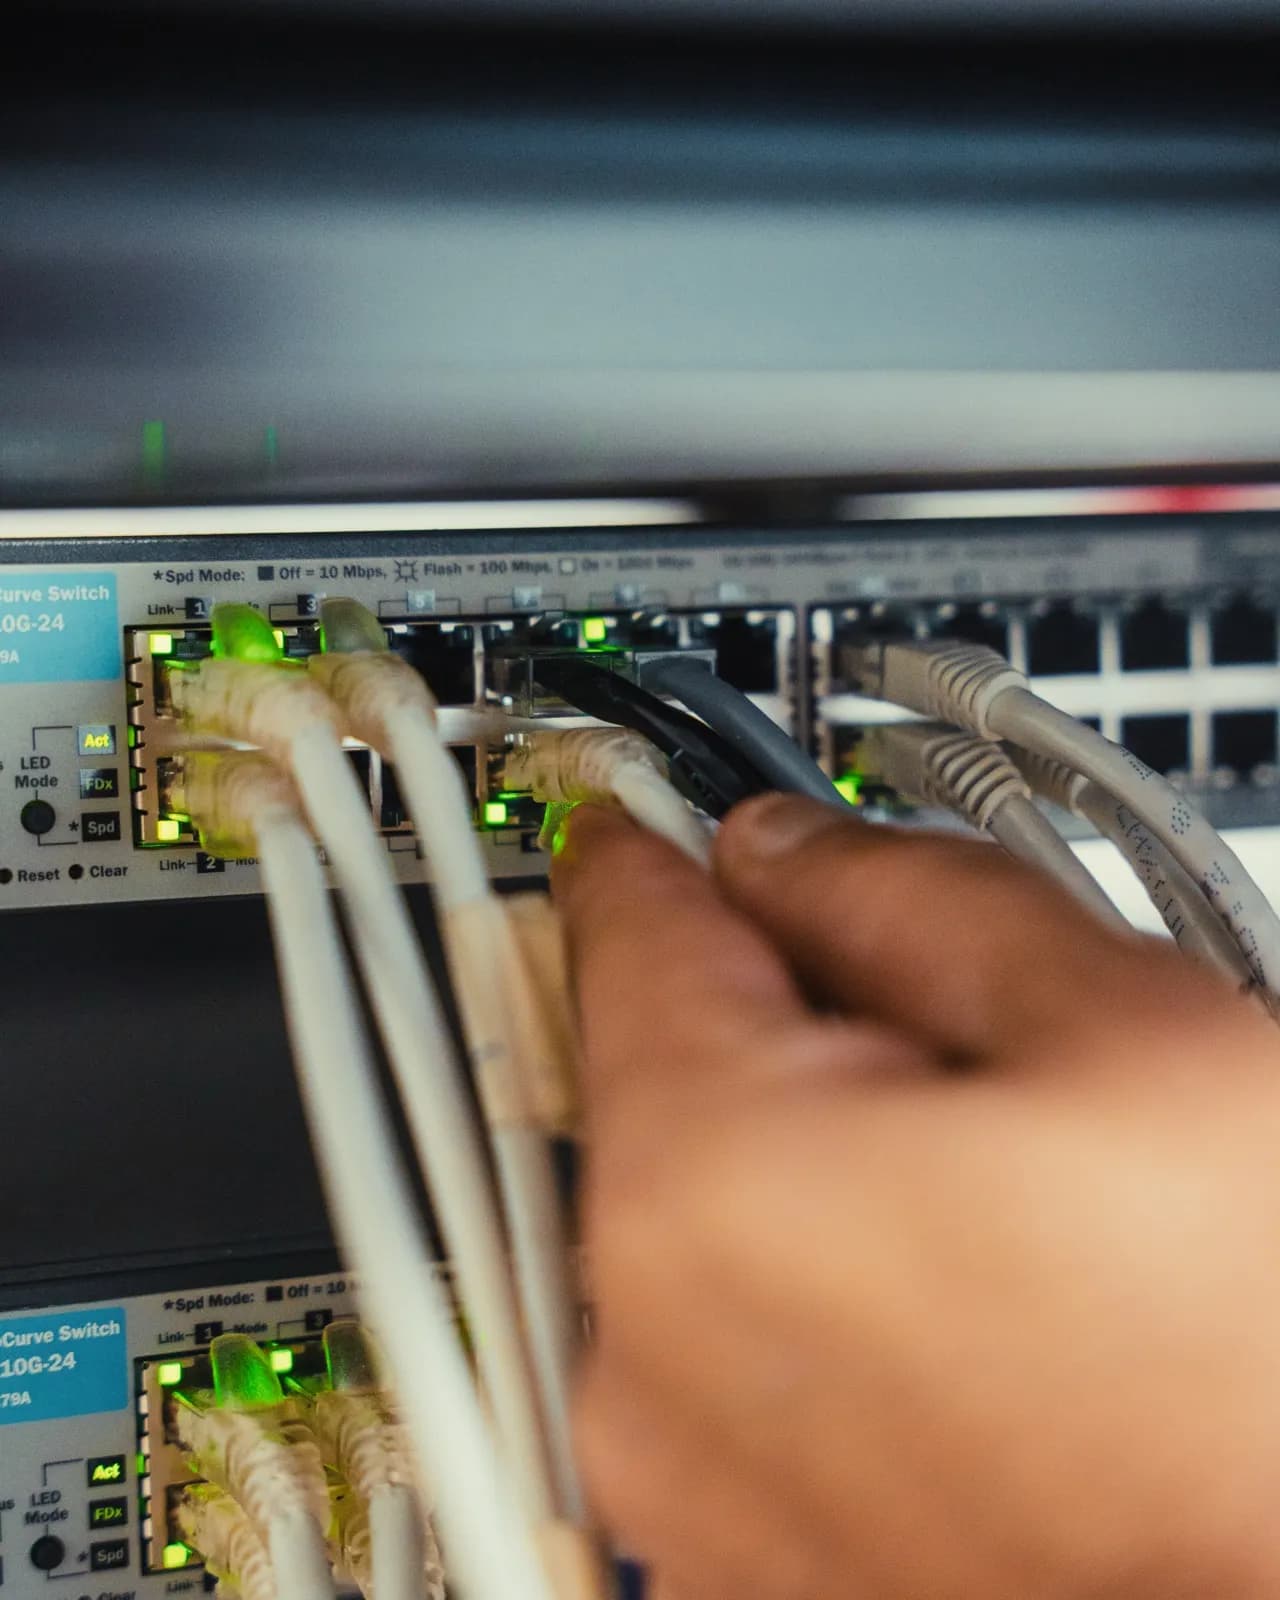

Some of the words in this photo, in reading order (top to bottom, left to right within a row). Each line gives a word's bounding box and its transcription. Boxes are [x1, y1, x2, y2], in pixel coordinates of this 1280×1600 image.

[199, 568, 246, 582] Mode:
[280, 565, 300, 579] Off
[319, 566, 338, 579] 10
[343, 564, 388, 580] Mbps,
[424, 562, 462, 577] Flash
[480, 560, 506, 575] 100
[48, 584, 110, 601] Switch
[148, 603, 175, 616] Link
[193, 602, 206, 616] 1
[84, 734, 110, 748] Act
[21, 756, 51, 770] LED
[15, 774, 58, 788] Mode
[85, 778, 113, 791] FDx
[87, 821, 116, 835] Spd
[159, 859, 186, 872] Link
[204, 857, 217, 870] 2
[18, 868, 60, 882] Reset
[90, 865, 129, 878] Clear
[209, 1292, 254, 1308] Mode:
[288, 1284, 309, 1298] Off
[327, 1281, 346, 1295] 10
[59, 1320, 121, 1342] Switch
[158, 1330, 185, 1344] Link
[233, 1321, 268, 1334] Mode
[92, 1462, 122, 1481] Act
[31, 1489, 62, 1507] LED
[24, 1507, 69, 1525] Mode
[94, 1507, 124, 1521] FDx
[97, 1548, 124, 1563] Spd
